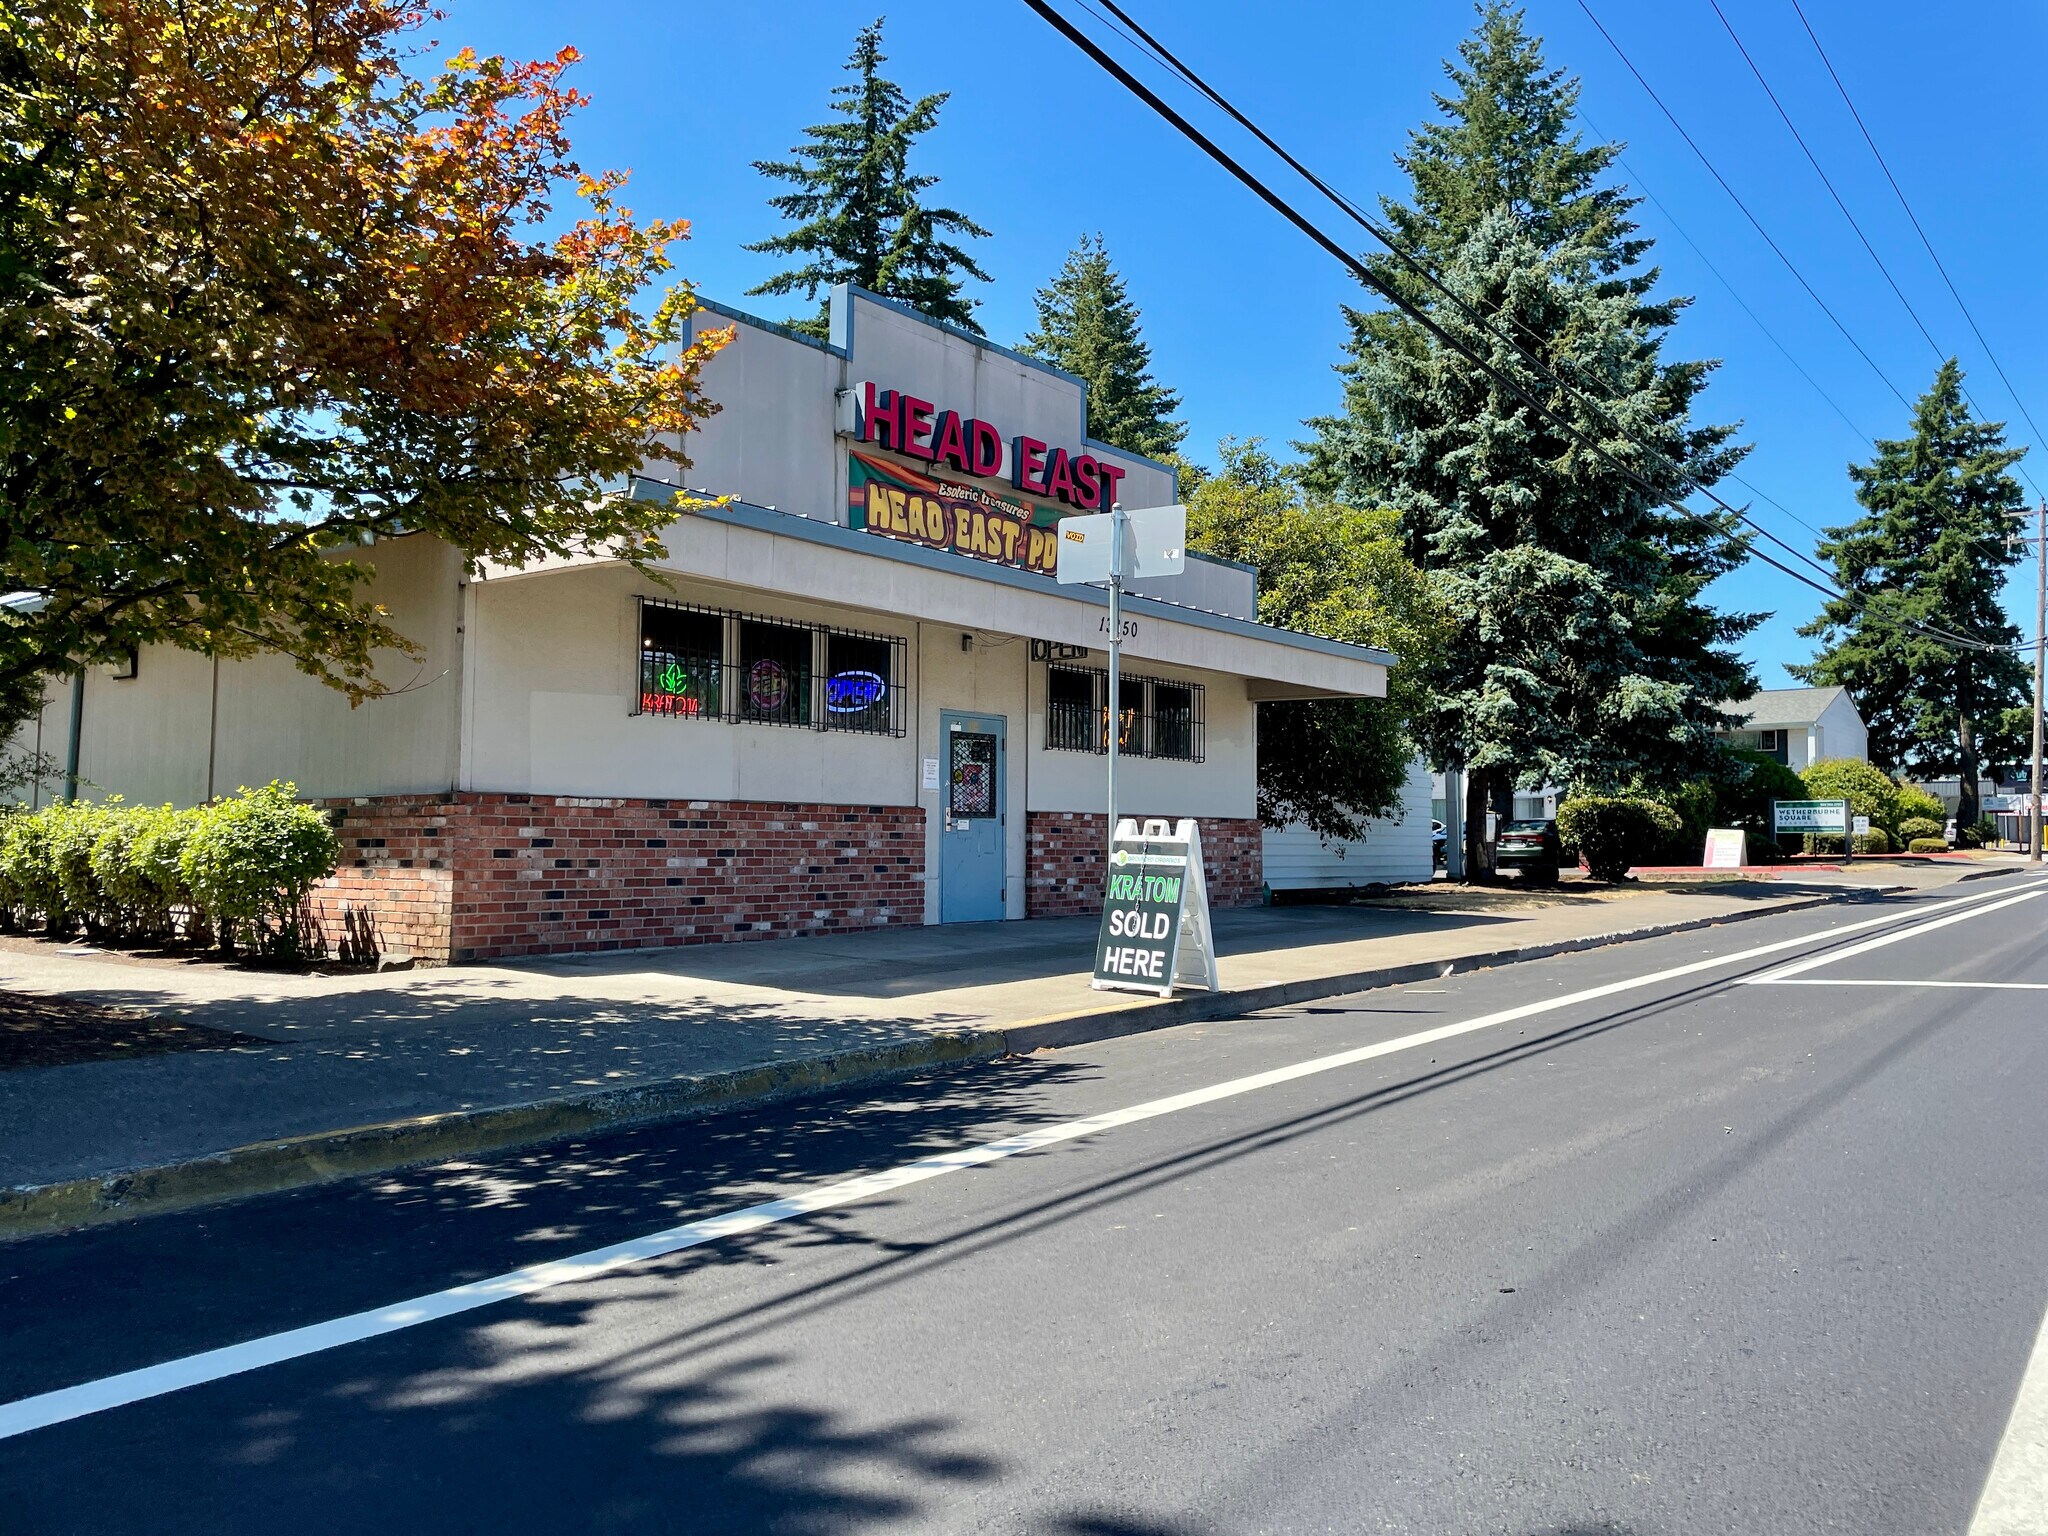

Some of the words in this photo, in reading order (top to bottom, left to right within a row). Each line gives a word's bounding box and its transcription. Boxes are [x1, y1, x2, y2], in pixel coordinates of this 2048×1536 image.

[858, 381, 1003, 478] HEAD
[1013, 436, 1126, 513] EAST
[938, 483, 979, 501] Esoteric
[982, 492, 1030, 520] treasures
[868, 483, 946, 541] HEAD
[954, 507, 1020, 560] EAST
[1028, 528, 1058, 569] PD
[1065, 530, 1084, 542] VOID
[1033, 638, 1086, 660] OPEN
[642, 693, 698, 715] KRATOM
[828, 678, 878, 704] OPEN
[1109, 874, 1181, 904] KRATOM
[1109, 909, 1170, 940] SOLD
[1103, 946, 1166, 978] HERE
